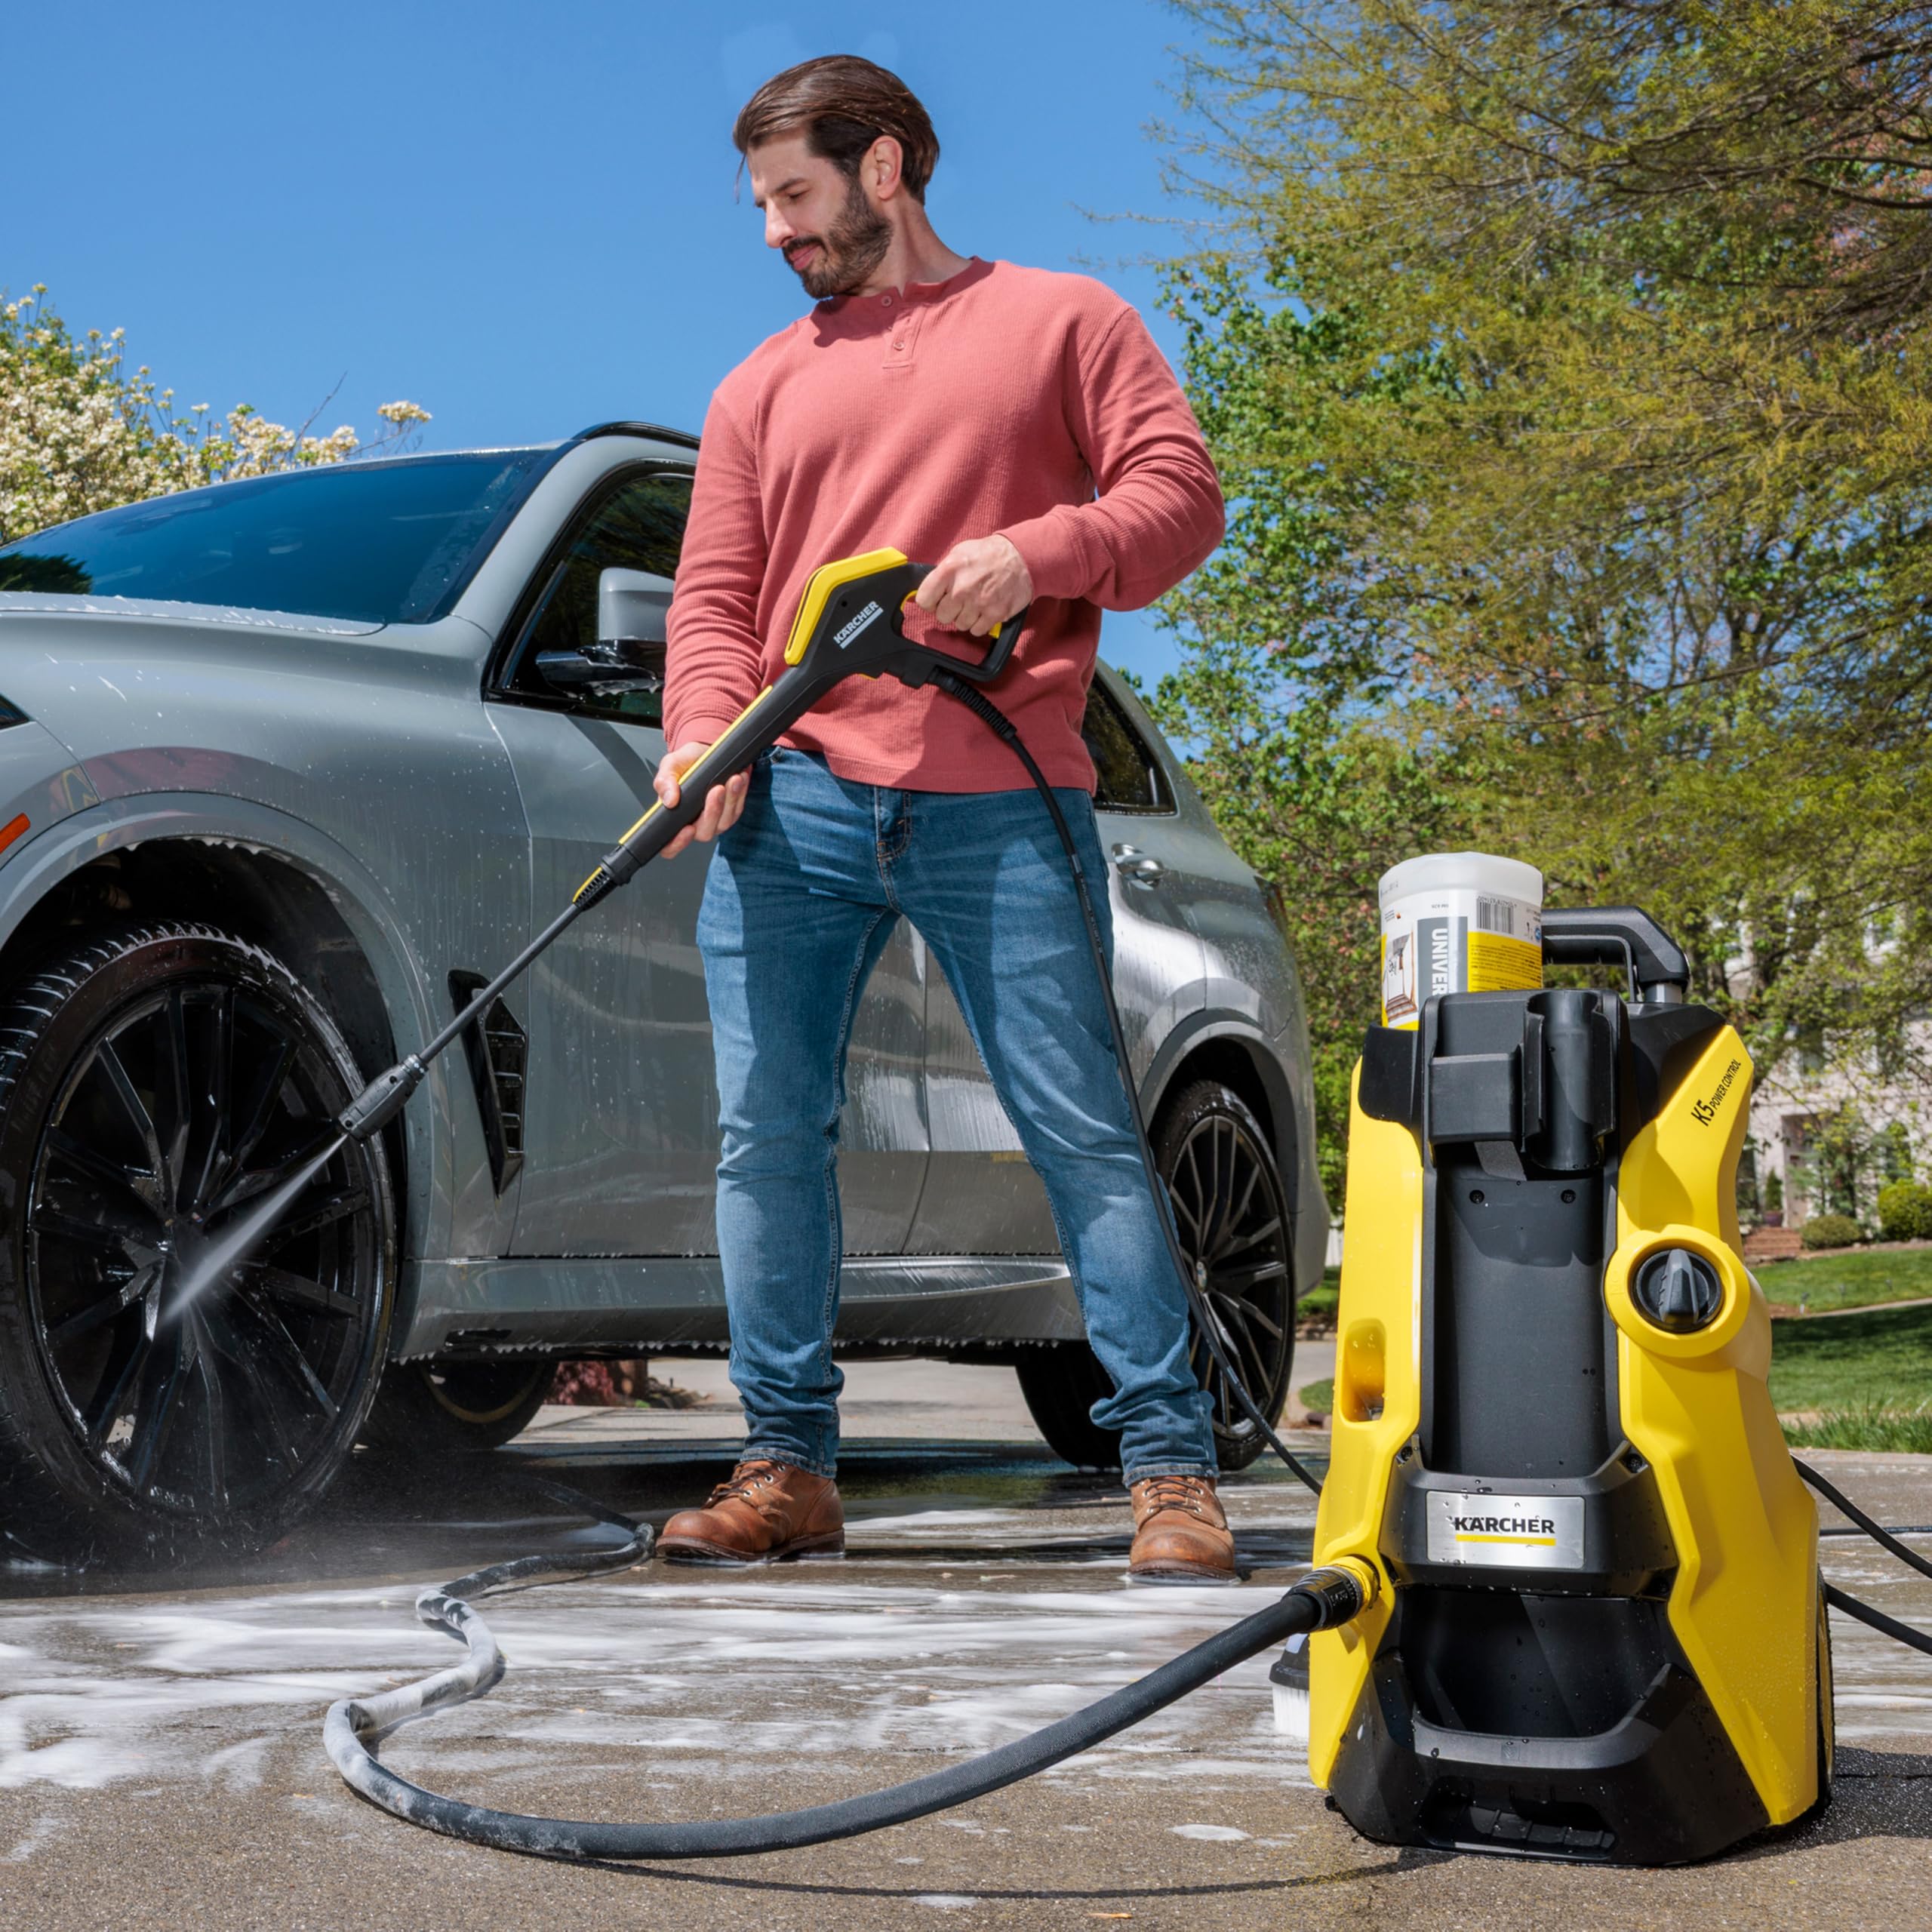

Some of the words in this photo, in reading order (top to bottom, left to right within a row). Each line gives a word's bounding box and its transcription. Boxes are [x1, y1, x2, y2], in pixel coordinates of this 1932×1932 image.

[833, 601, 879, 644] KÄRCHER
[1690, 1099, 1715, 1127] K5
[1709, 1084, 1727, 1110] POWER
[1721, 1059, 1742, 1088] CONTROL
[1454, 1517, 1555, 1534] KÄRCHER
